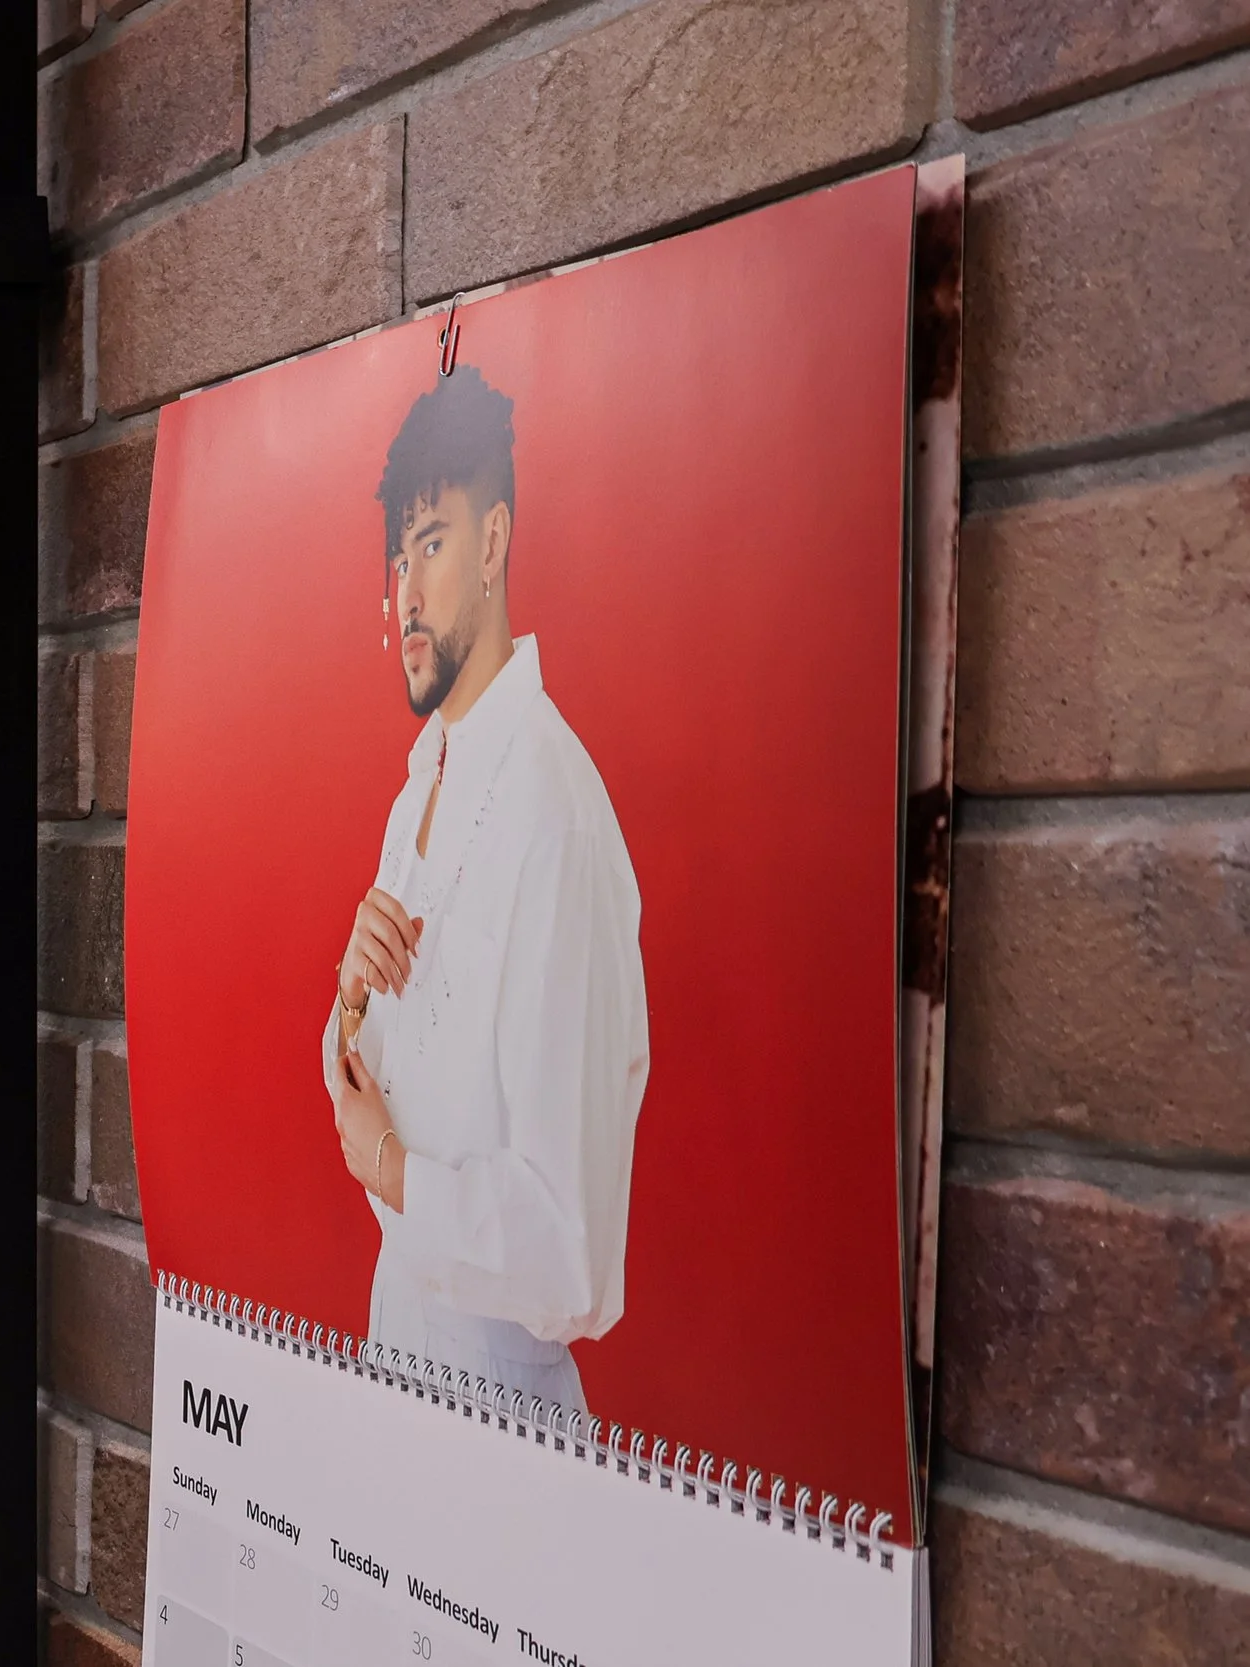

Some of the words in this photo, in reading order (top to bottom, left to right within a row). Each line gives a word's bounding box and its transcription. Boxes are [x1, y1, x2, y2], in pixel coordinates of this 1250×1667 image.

[182, 1379, 249, 1447] MAY
[163, 1507, 180, 1531] 27
[239, 1544, 256, 1570] 28
[321, 1584, 339, 1611] 29
[412, 1631, 432, 1660] 30
[173, 1466, 217, 1506] Sunday
[246, 1499, 300, 1545] Monday
[330, 1537, 389, 1588] Tuesday
[407, 1574, 499, 1643] Wednesday
[517, 1628, 586, 1667] Thursd
[159, 1604, 168, 1625] 4
[234, 1644, 244, 1667] 5
